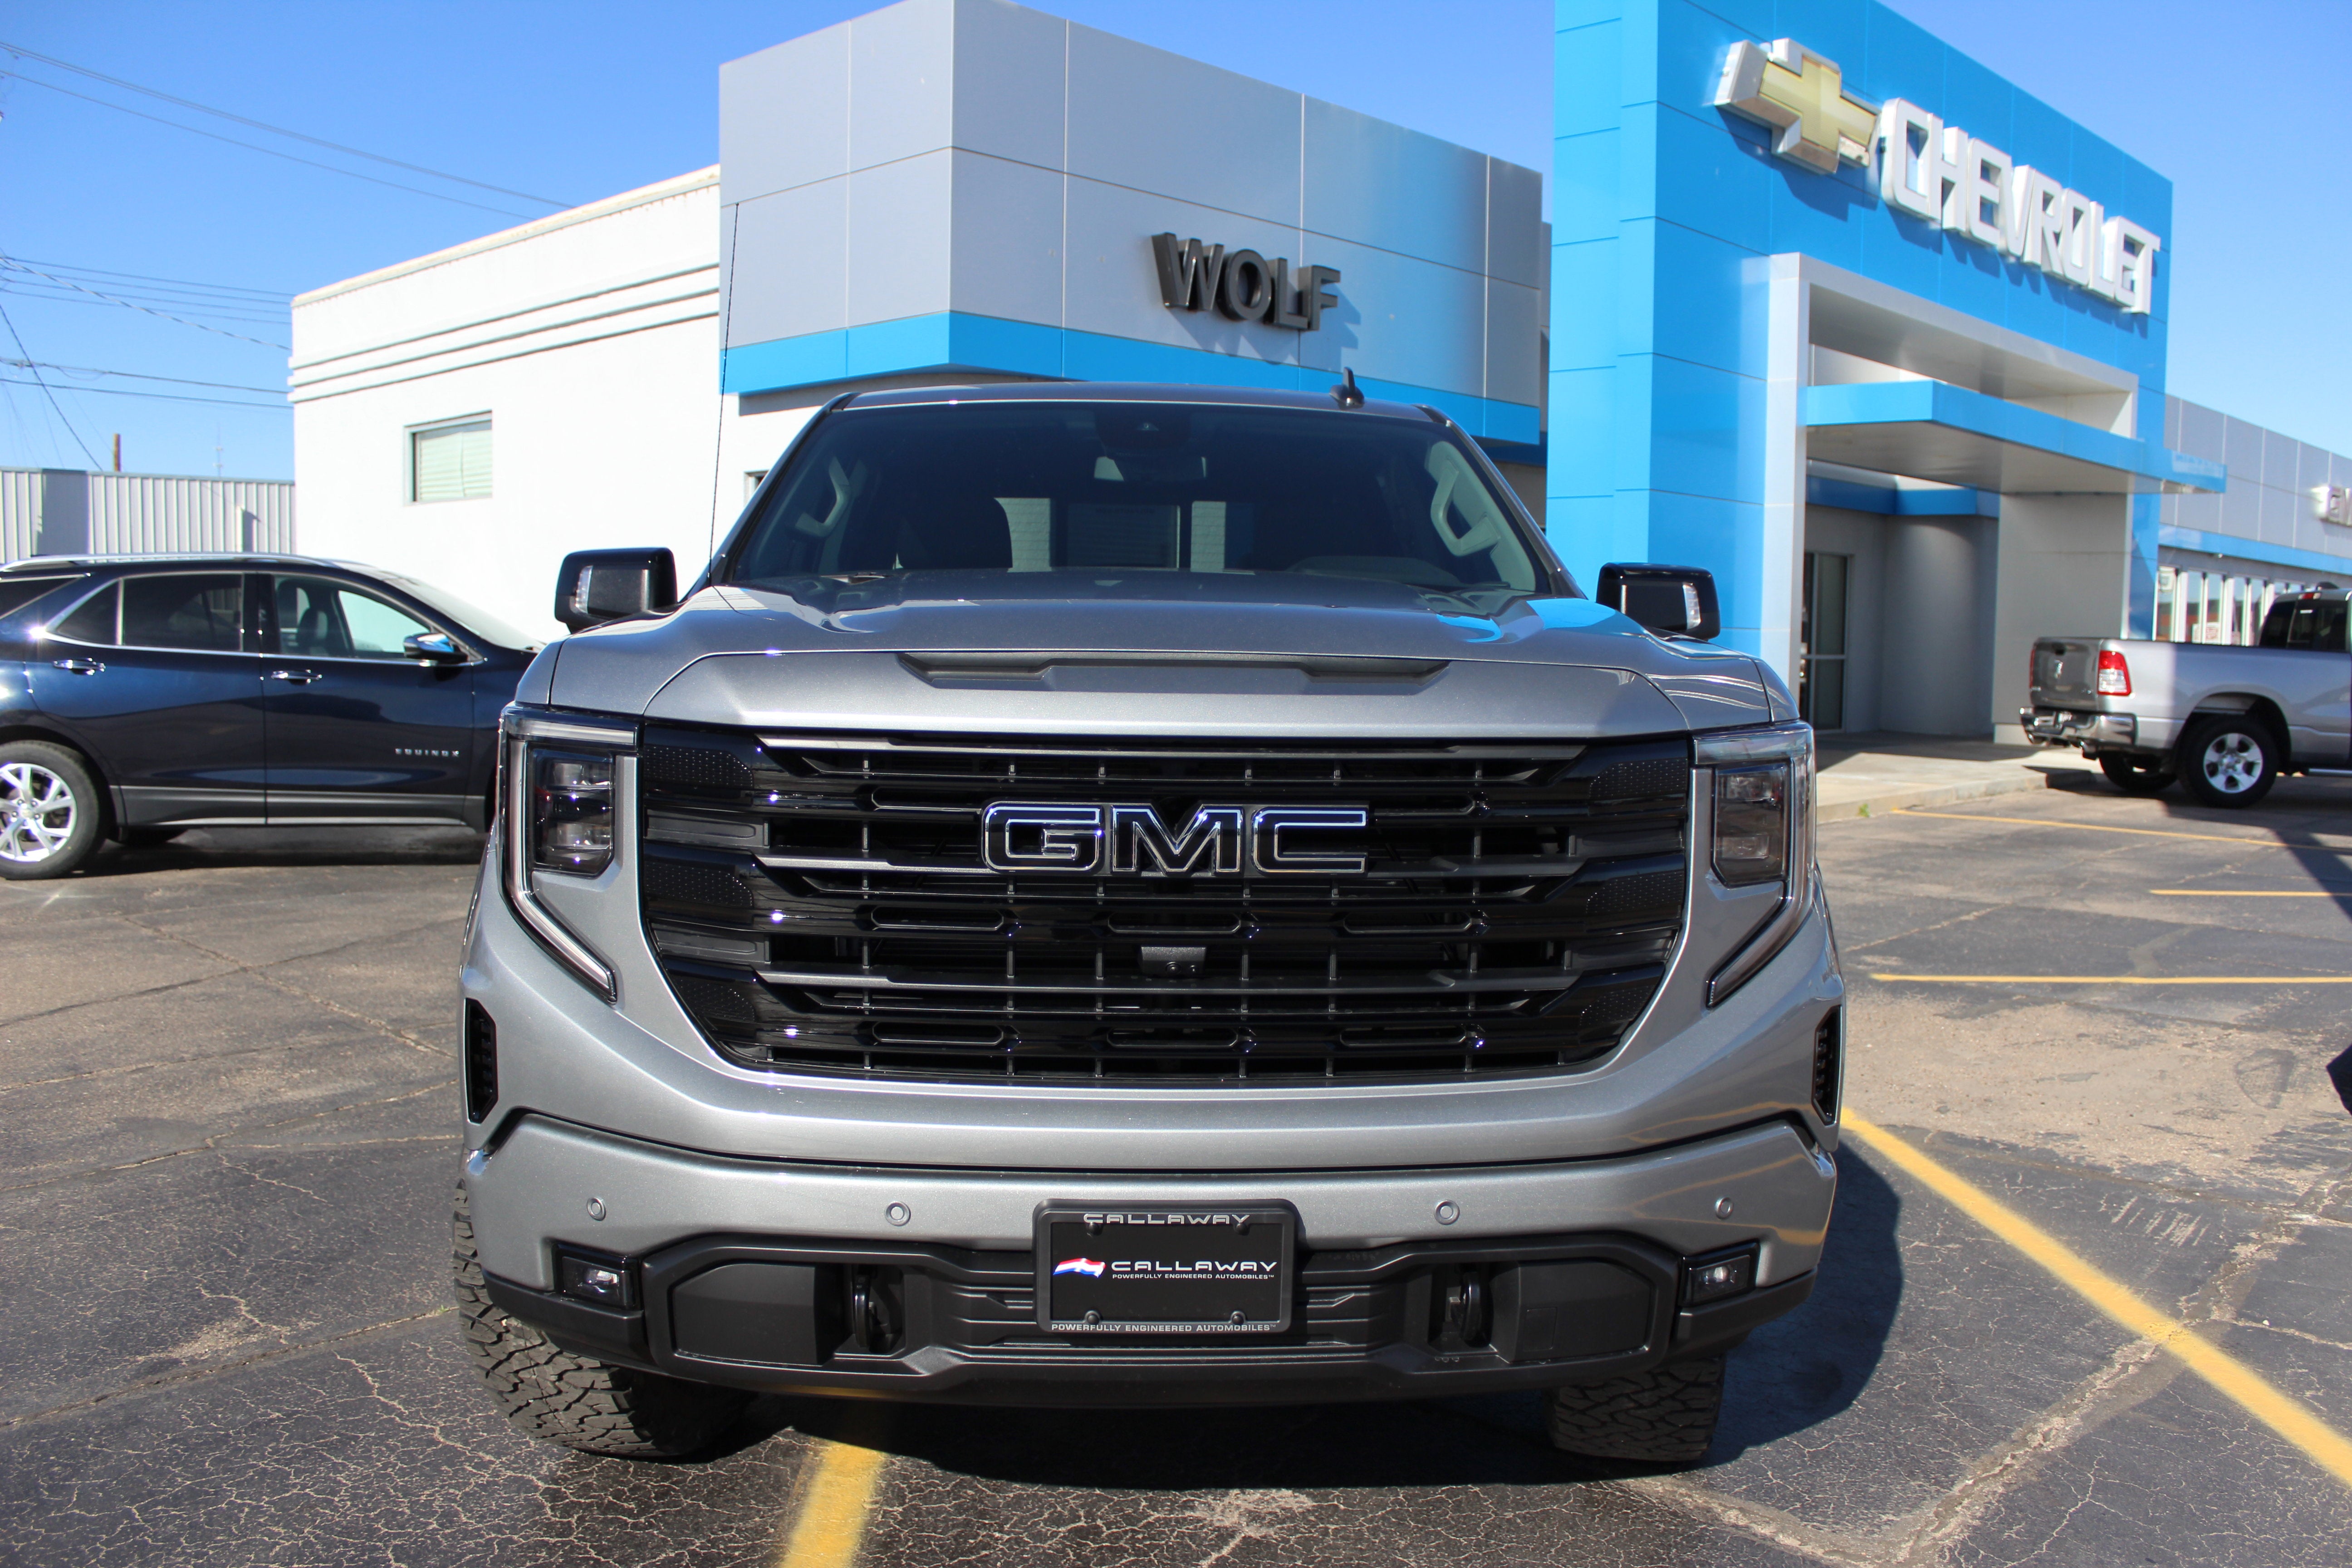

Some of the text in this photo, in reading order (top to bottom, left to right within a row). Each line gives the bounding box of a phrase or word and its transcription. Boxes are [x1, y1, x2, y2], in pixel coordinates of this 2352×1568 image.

[1881, 98, 2161, 315] CHEVROLET
[1152, 232, 1341, 331] WOLF
[395, 748, 459, 757] EQUINOX
[983, 803, 1367, 874] GMC
[1083, 1213, 1250, 1224] CALLAWAY
[1111, 1261, 1278, 1272] CALLAWAY
